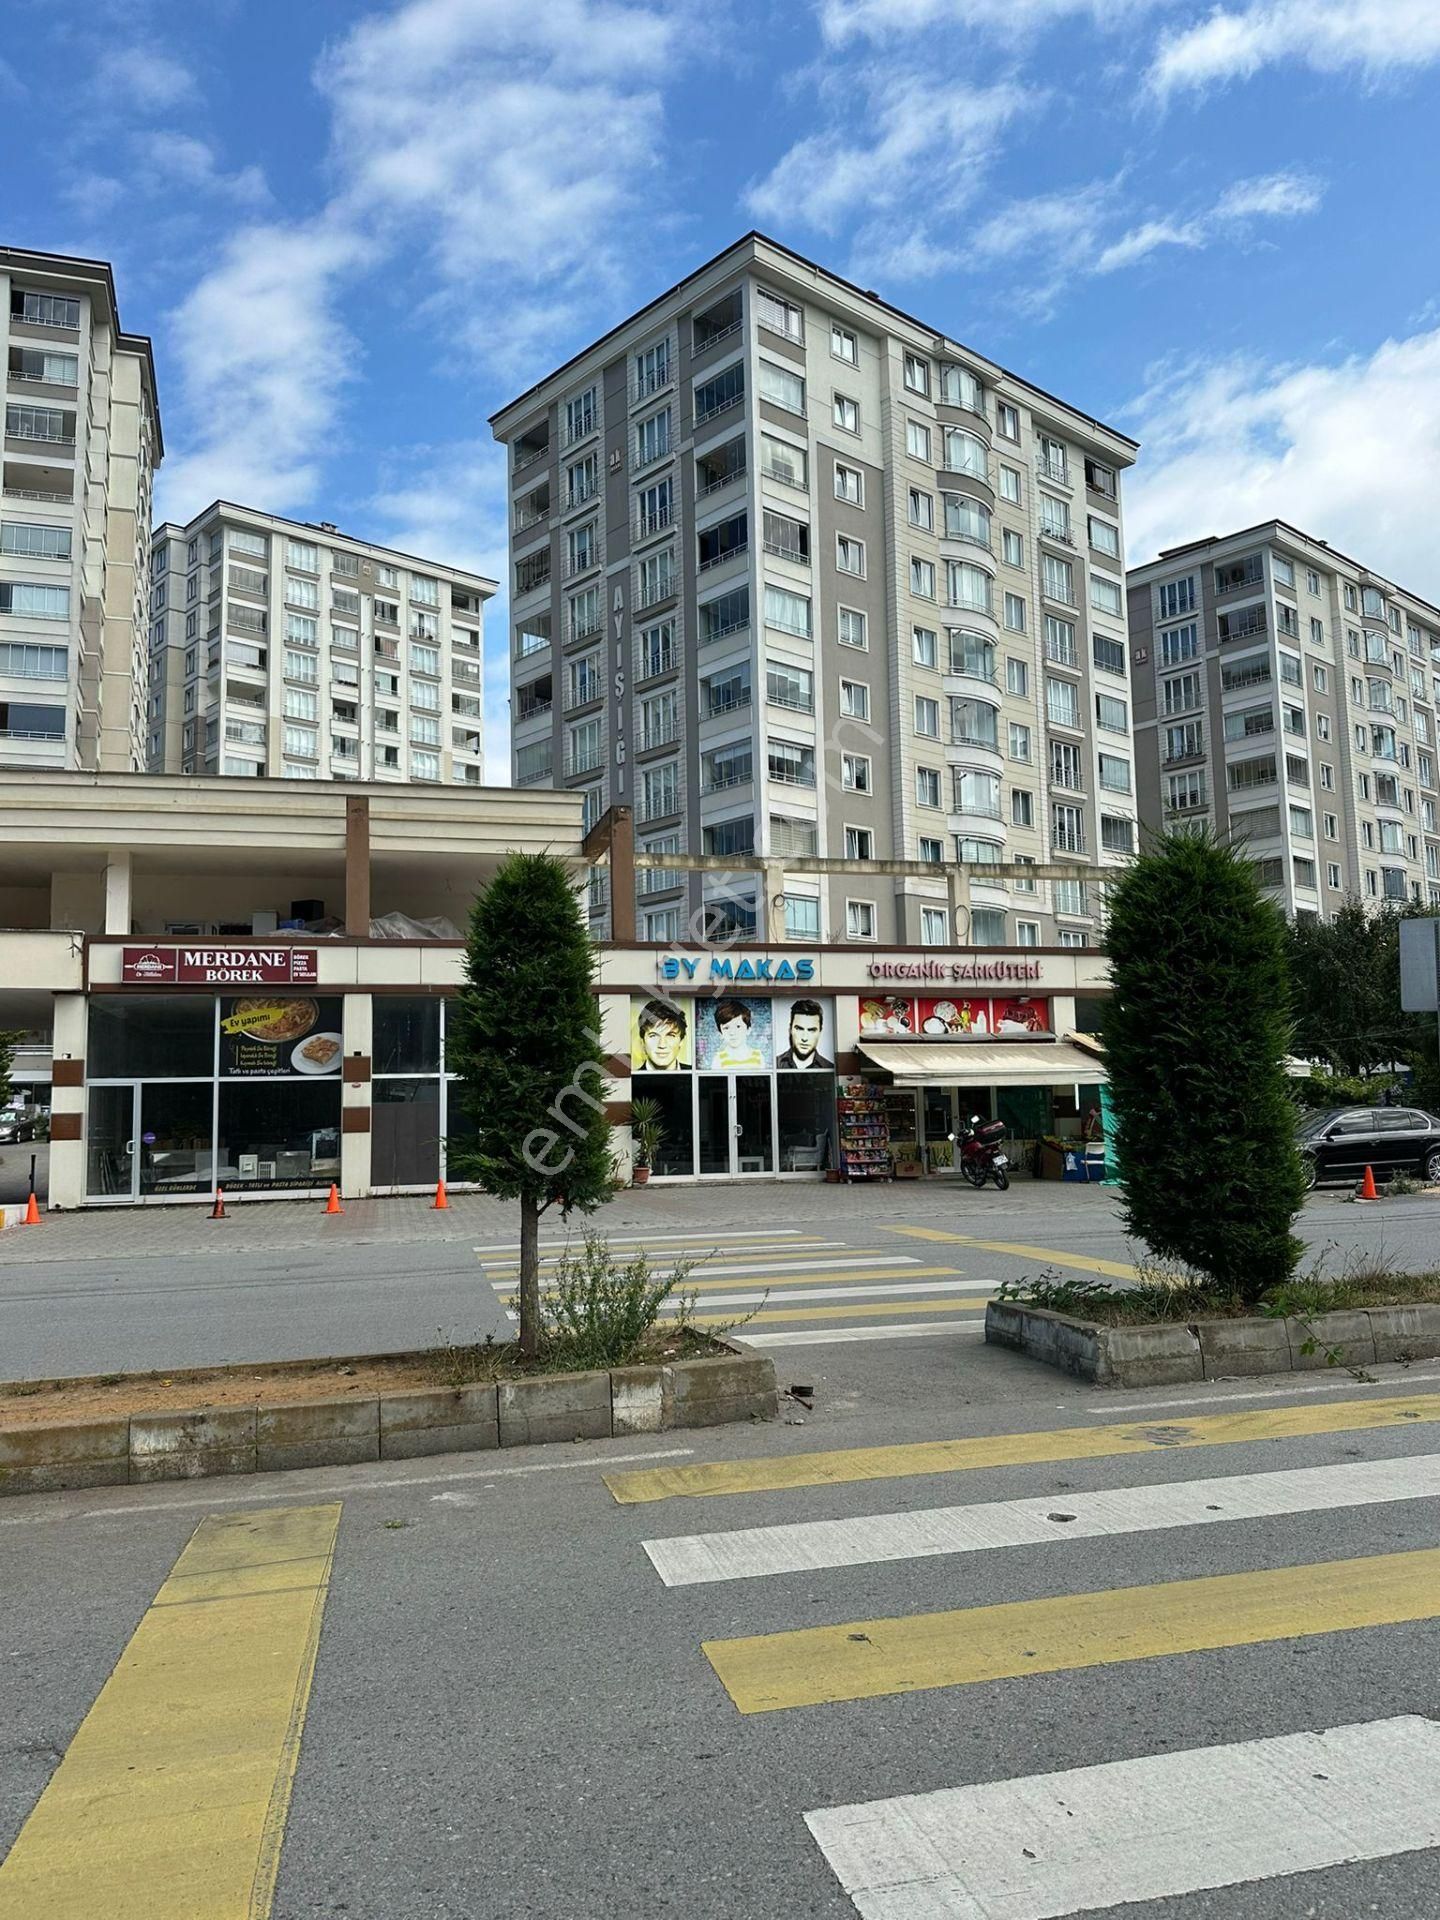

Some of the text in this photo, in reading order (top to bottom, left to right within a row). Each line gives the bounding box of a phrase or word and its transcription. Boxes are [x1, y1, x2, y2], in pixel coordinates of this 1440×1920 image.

[613, 585, 626, 795] AYIŞIĞI
[183, 951, 287, 967] MERDANE
[205, 967, 264, 982] BÖREK
[660, 957, 815, 981] BY MAKAS
[869, 960, 1042, 982] ORGANİK ŞARKÜTERİ
[230, 1014, 271, 1027] Ev yapımı
